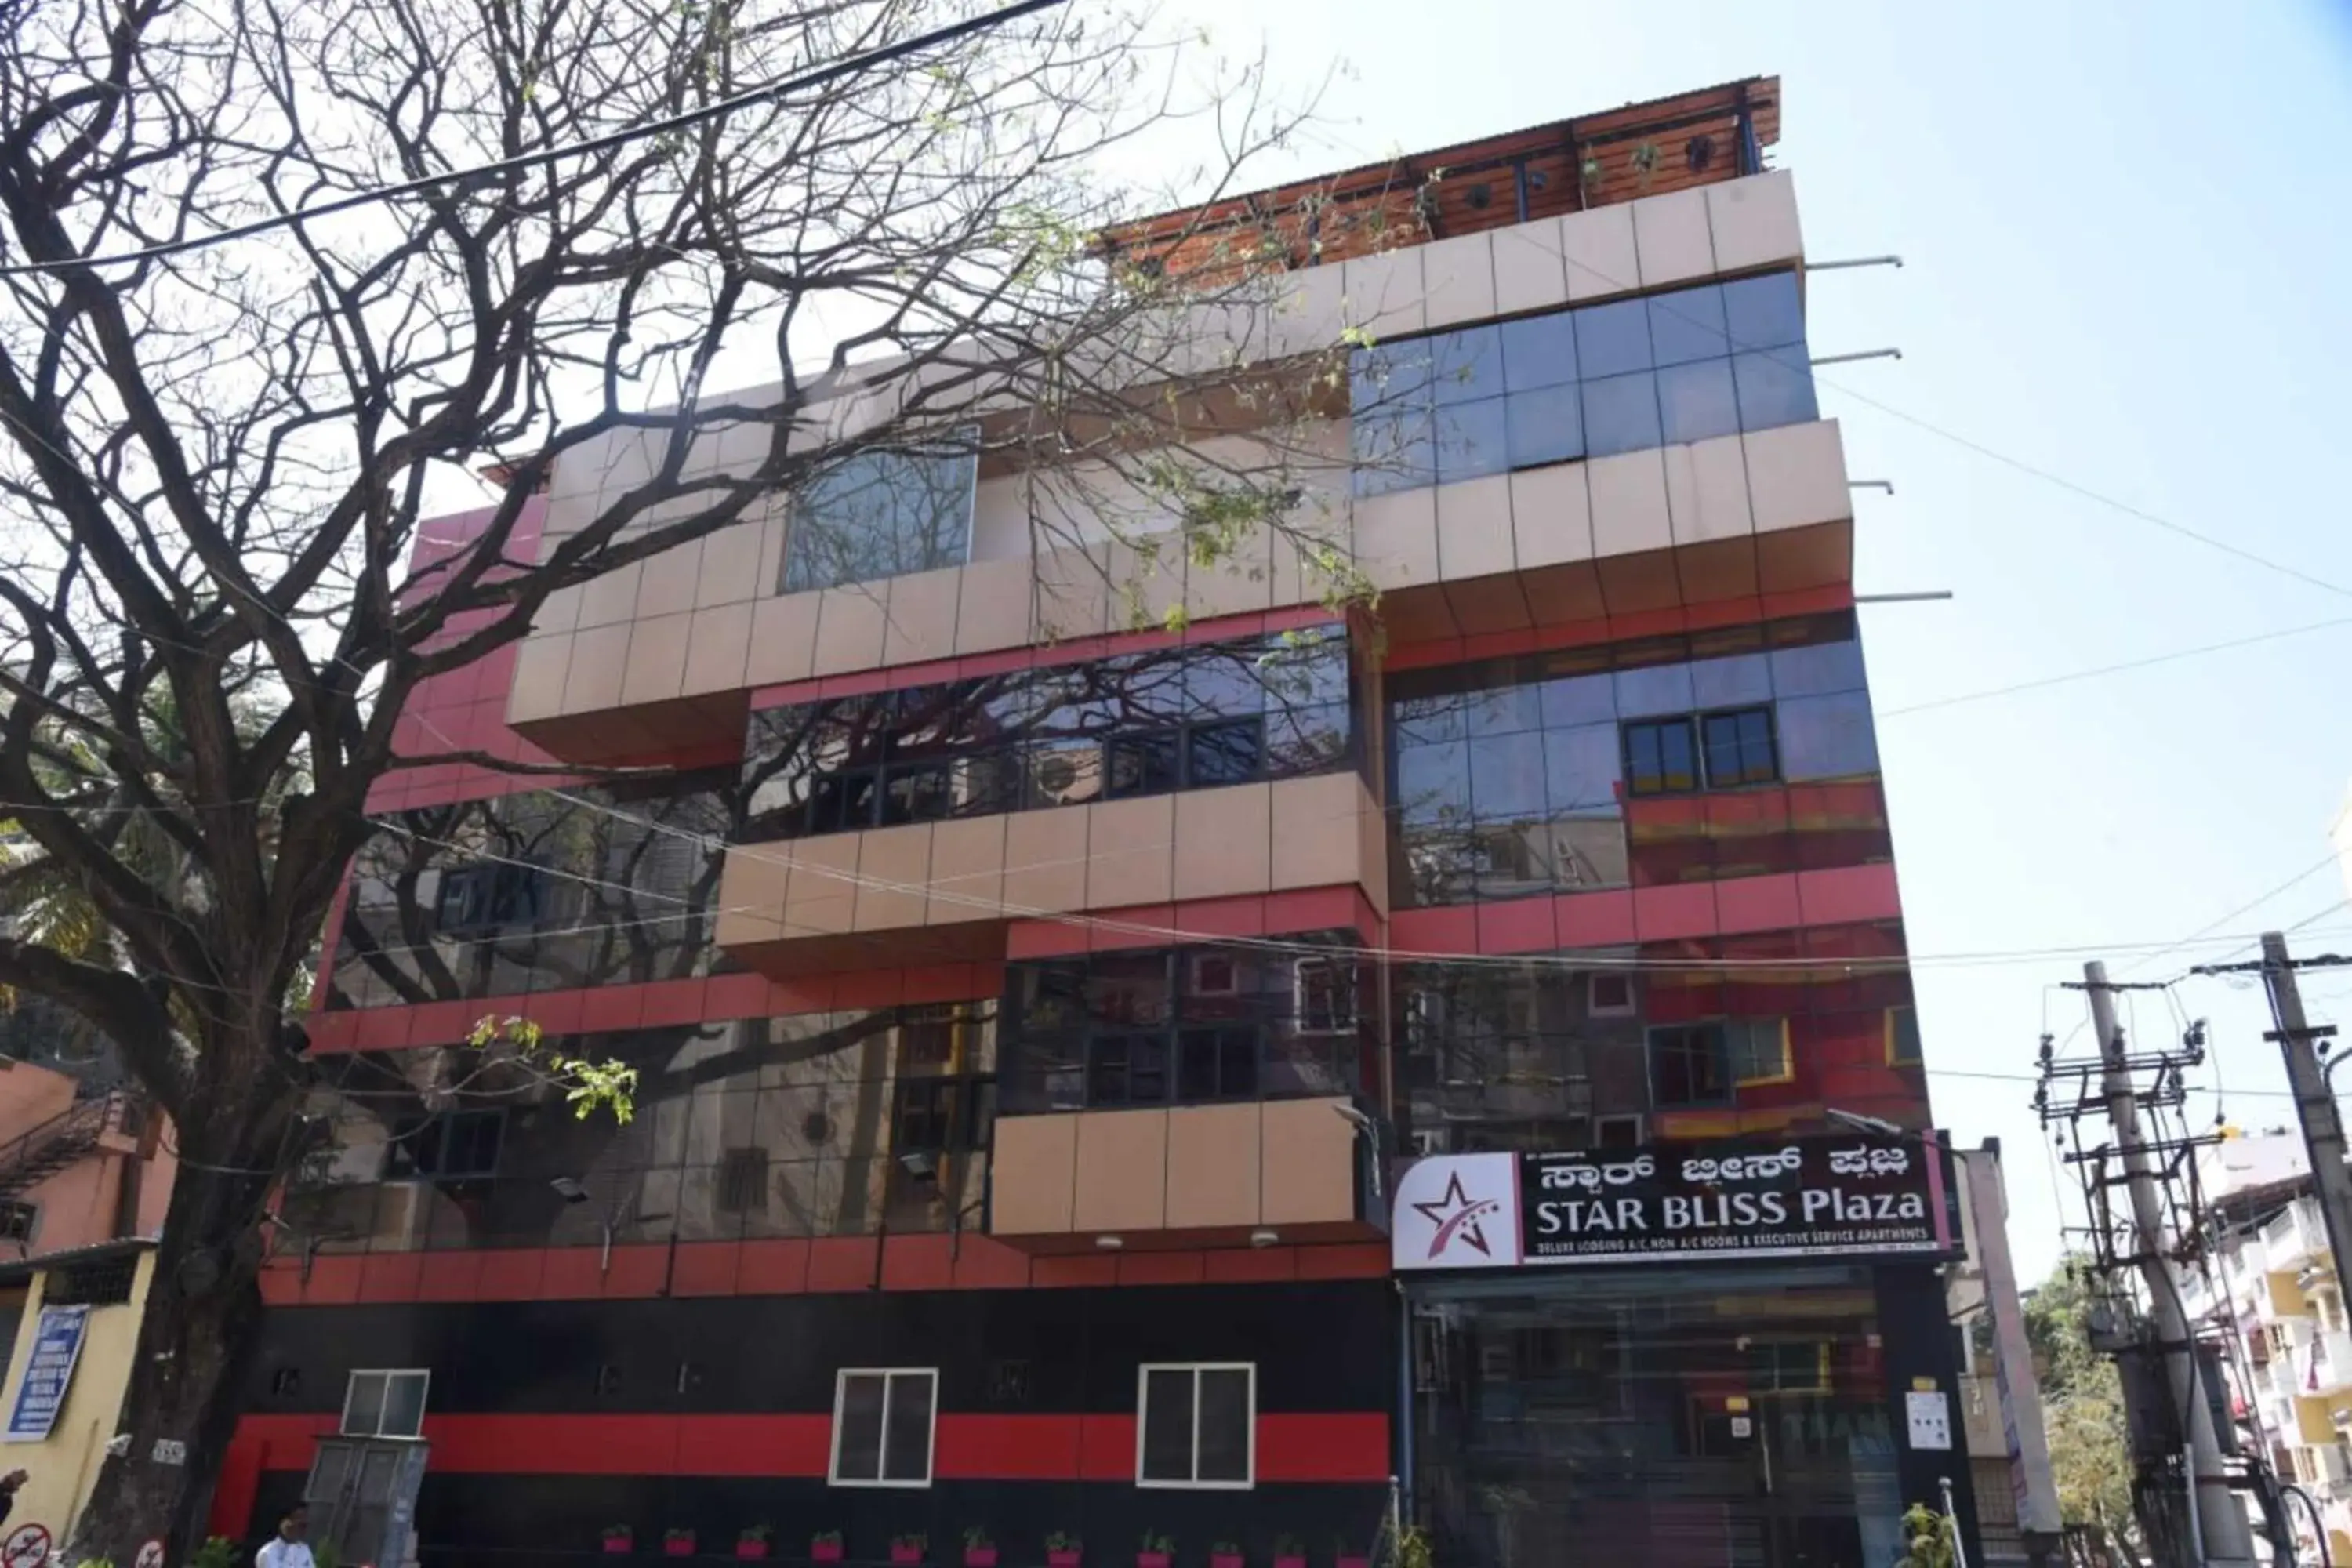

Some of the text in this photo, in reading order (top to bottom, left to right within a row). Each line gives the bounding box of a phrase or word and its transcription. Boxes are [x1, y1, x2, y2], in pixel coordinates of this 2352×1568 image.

[1541, 1154, 1655, 1194] ಸ್ಟಾರ್
[1537, 1187, 1925, 1234] STAR BLISS Plaza
[1537, 1240, 1574, 1254] DELUXE
[1577, 1238, 1625, 1253] LODGING
[1650, 1236, 1675, 1249] NON
[1680, 1236, 1699, 1249] A/C
[1702, 1234, 1740, 1247] ROOMS
[1743, 1233, 1750, 1246] &
[1754, 1232, 1809, 1245] EXECUTIVE
[1812, 1229, 1853, 1243] SERVICE
[1857, 1226, 1929, 1241] APARTMENTS
